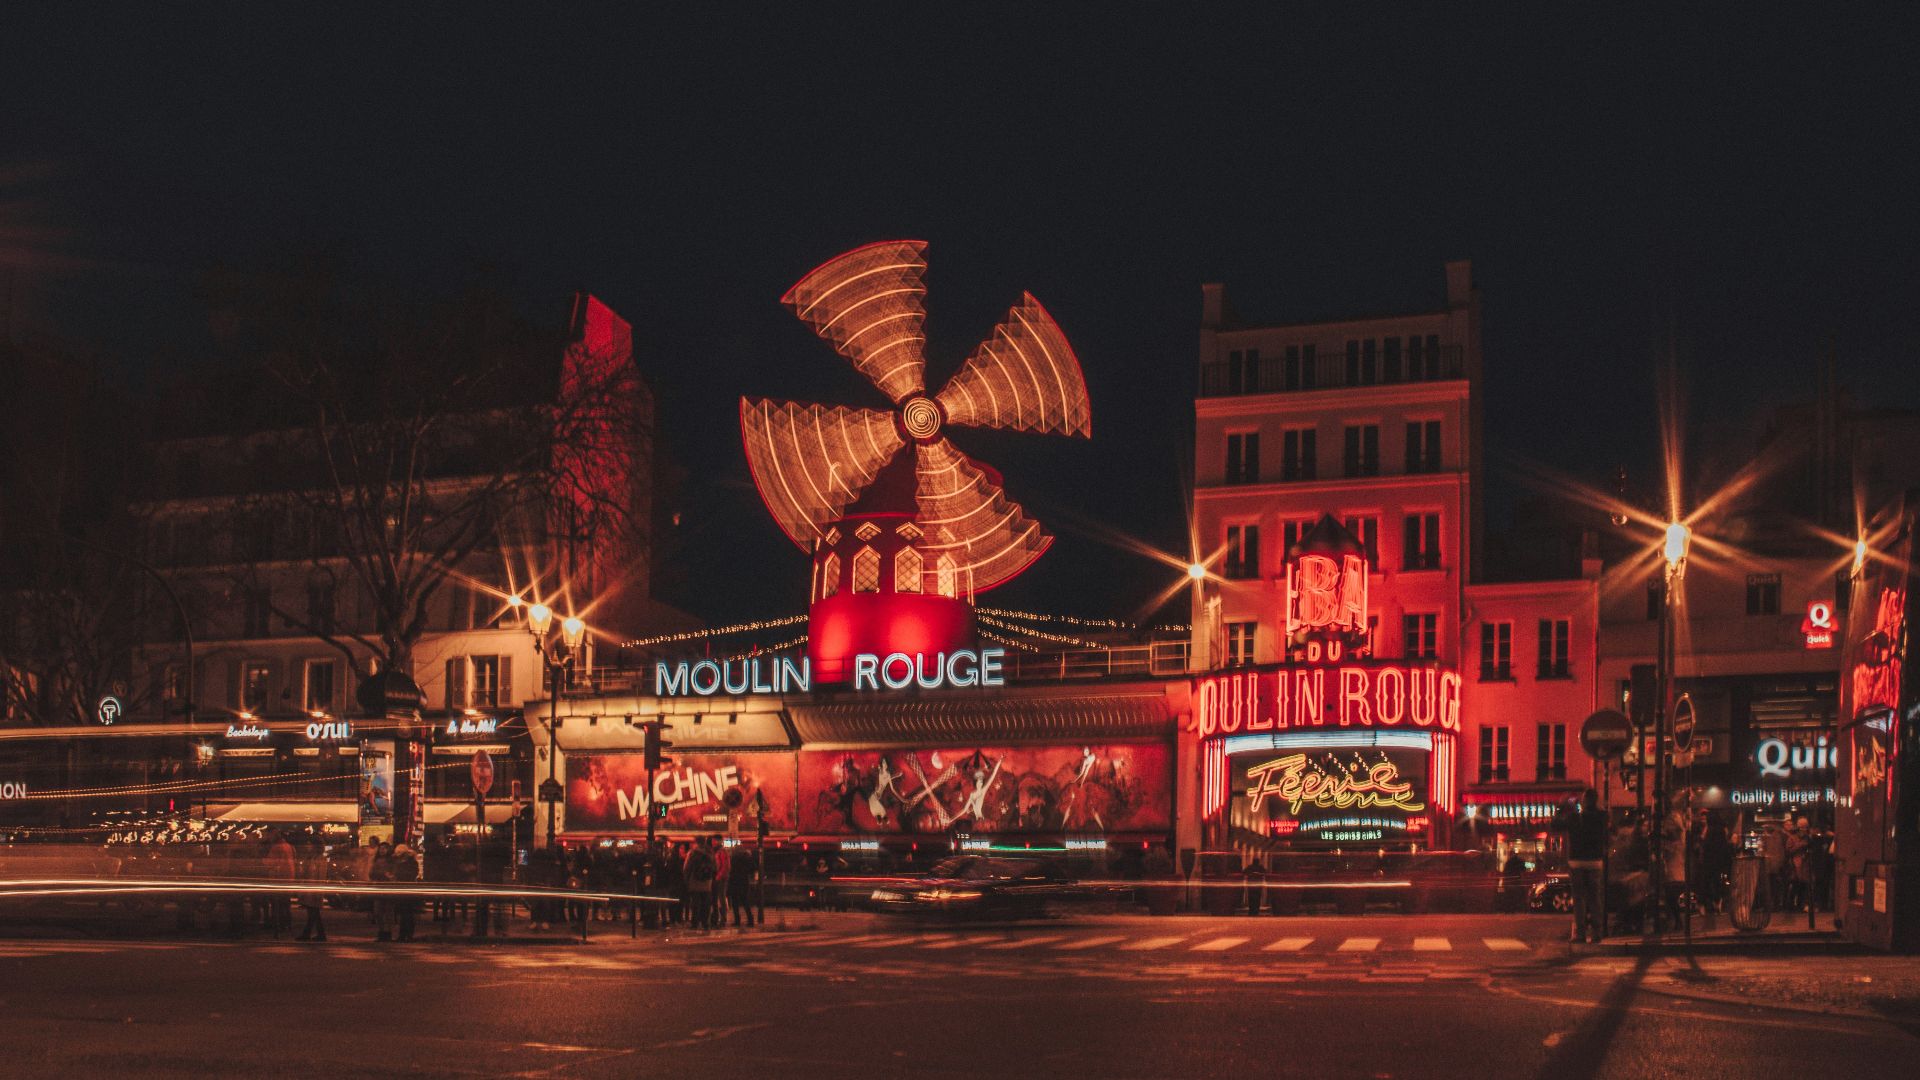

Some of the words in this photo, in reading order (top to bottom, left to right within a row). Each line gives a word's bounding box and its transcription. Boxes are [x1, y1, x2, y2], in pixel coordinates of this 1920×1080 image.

[1810, 603, 1831, 628] Q
[1807, 634, 1830, 644] Quick
[1308, 641, 1341, 662] DU
[656, 656, 811, 696] MOULIN
[855, 649, 1005, 690] ROUGE
[1200, 669, 1325, 739] OULIN
[1340, 667, 1461, 732] ROUG
[1732, 788, 1774, 805] Quality
[1780, 788, 1820, 803] Burger
[1362, 829, 1382, 841] GIRLS
